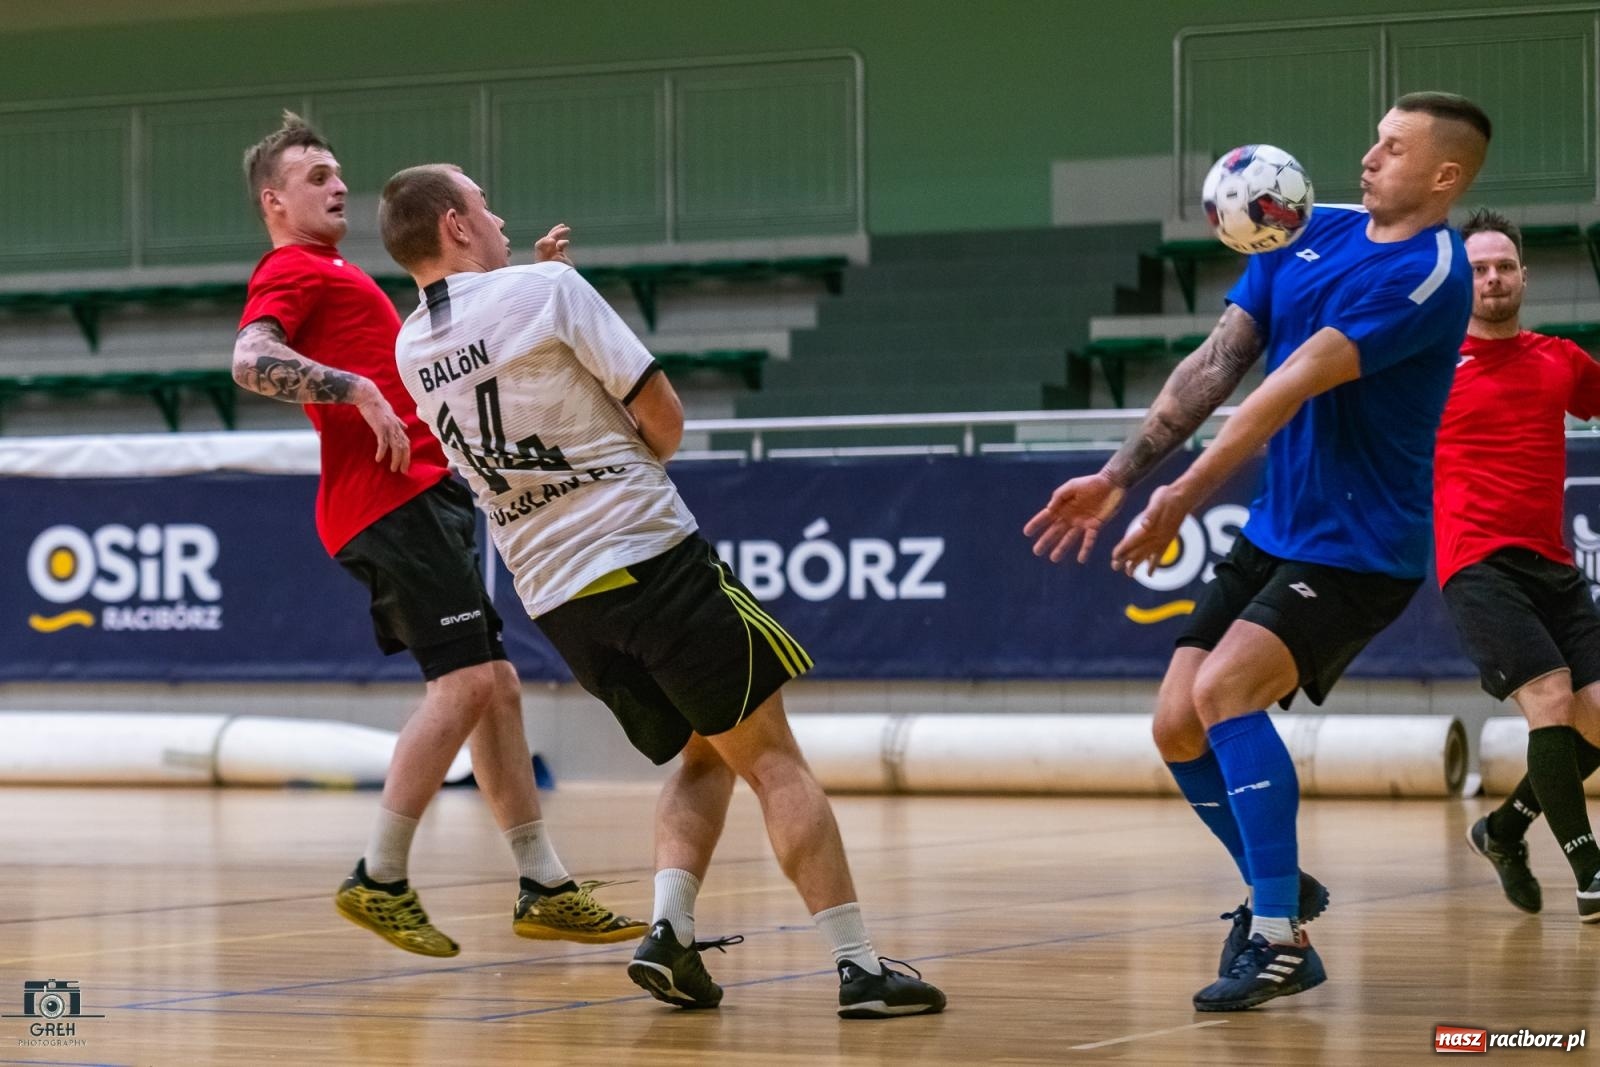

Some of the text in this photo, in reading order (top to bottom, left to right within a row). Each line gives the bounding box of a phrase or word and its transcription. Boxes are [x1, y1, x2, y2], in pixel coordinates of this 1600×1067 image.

[418, 339, 490, 393] BALöN
[437, 376, 573, 495] 14
[102, 602, 223, 630] RACIBÓRZ
